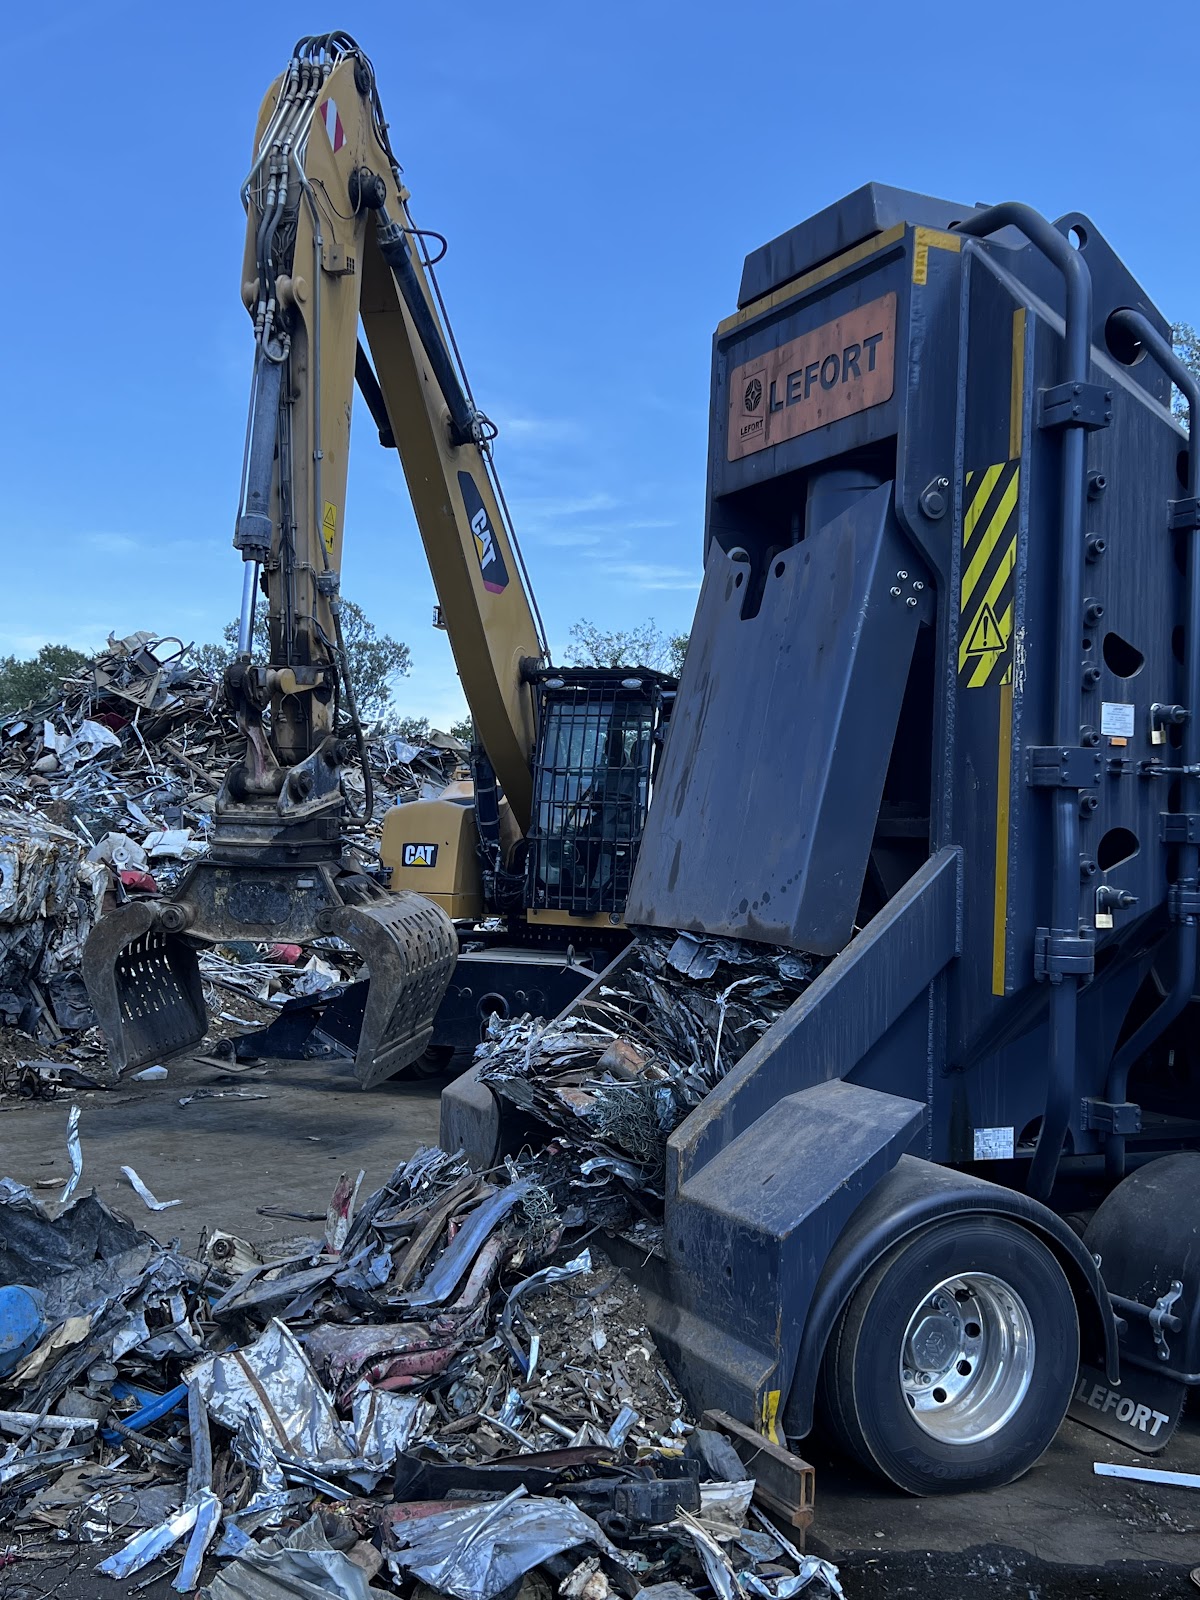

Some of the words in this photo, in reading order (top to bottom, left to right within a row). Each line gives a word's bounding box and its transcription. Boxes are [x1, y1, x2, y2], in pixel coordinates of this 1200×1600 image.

[769, 331, 884, 414] LEFORT
[740, 419, 764, 436] LEFORT
[471, 507, 497, 570] CAT
[404, 844, 435, 865] CAT
[1074, 1378, 1170, 1437] LEFORT
